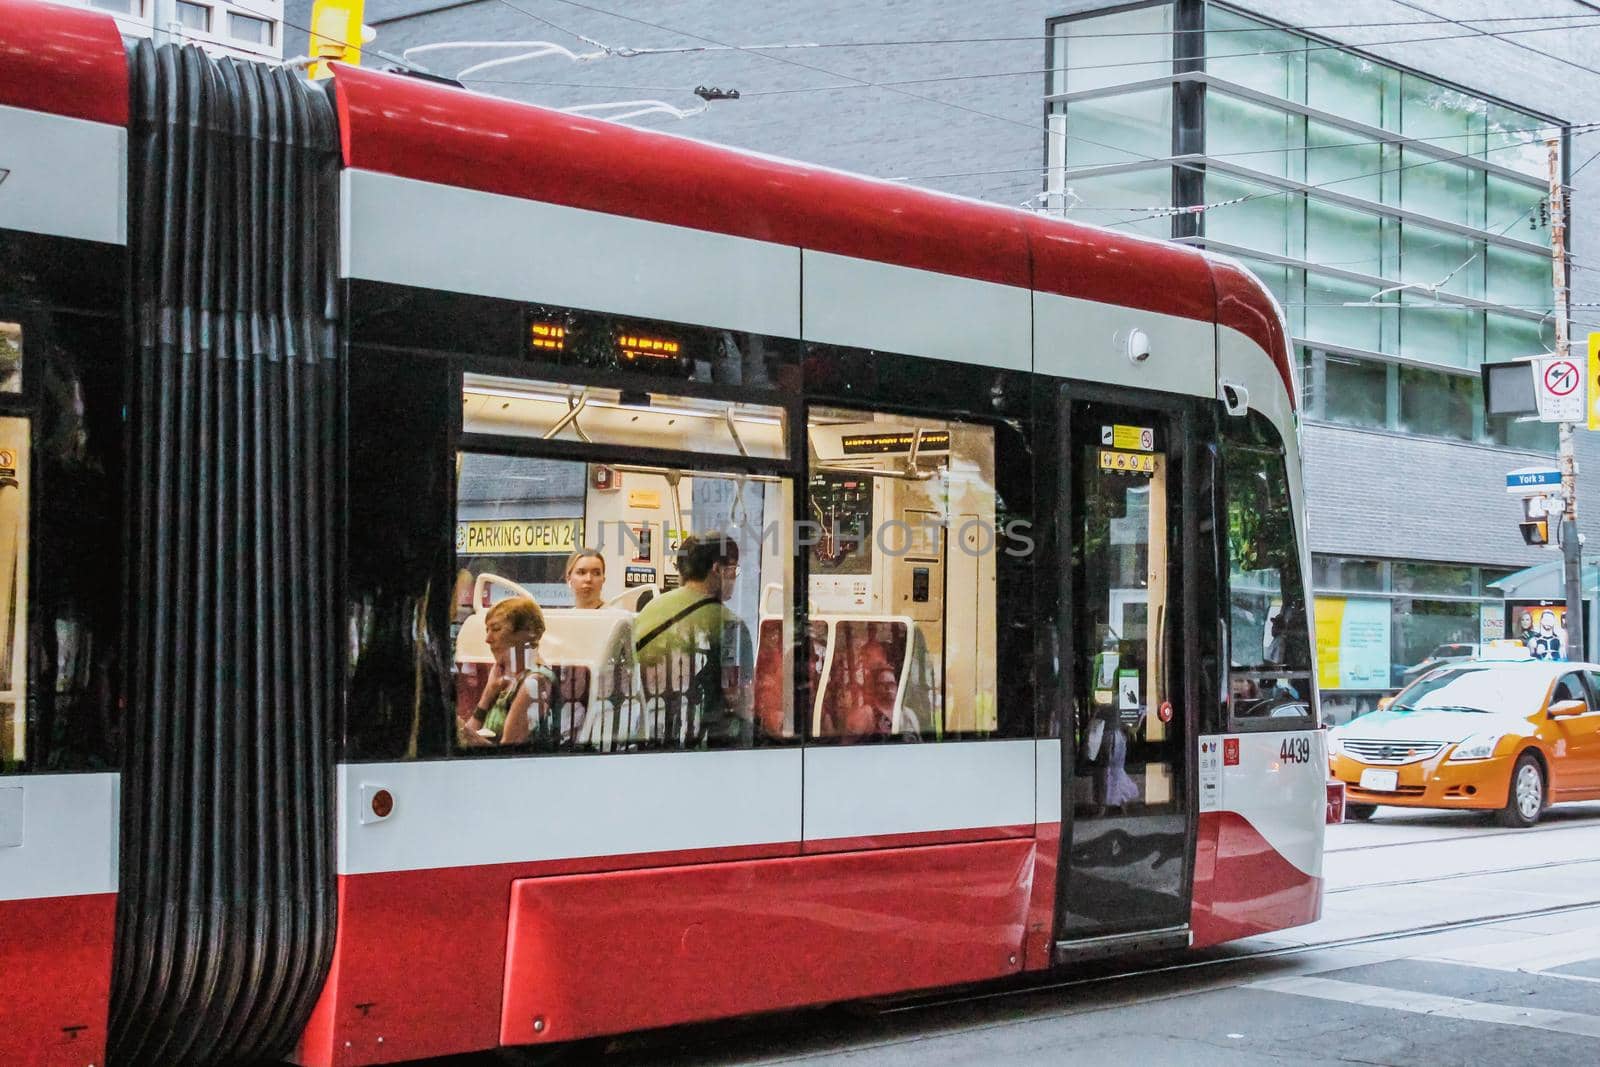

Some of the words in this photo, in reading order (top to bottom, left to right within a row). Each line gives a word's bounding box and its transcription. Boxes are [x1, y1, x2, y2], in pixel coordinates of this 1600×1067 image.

[1519, 475, 1537, 485] York
[468, 526, 521, 547] PARKING
[525, 526, 559, 546] OPEN
[1280, 737, 1310, 764] 4439
